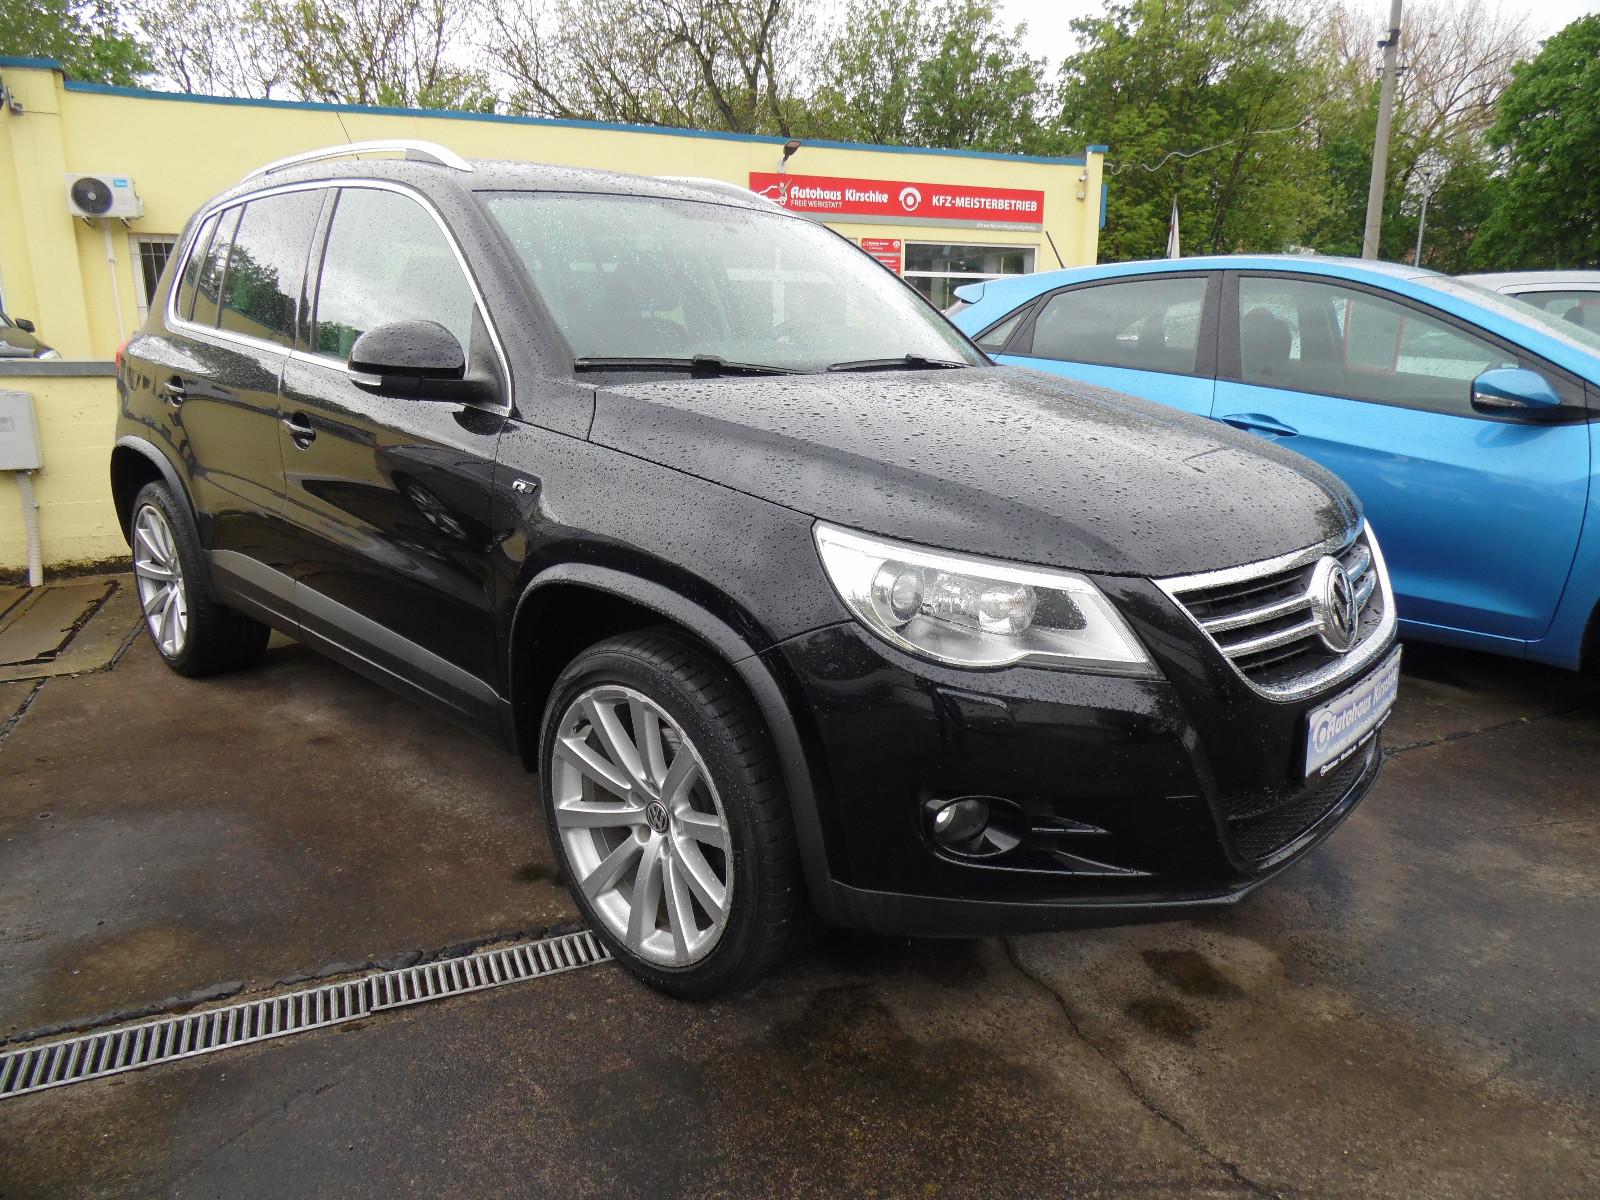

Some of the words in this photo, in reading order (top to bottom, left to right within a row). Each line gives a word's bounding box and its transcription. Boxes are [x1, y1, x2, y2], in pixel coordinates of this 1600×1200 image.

[790, 186, 842, 201] Autohaus
[845, 188, 888, 203] Kirschke
[790, 200, 807, 208] FREIE
[807, 200, 842, 209] WERKSTATT
[932, 195, 1038, 212] KFZ-MEISTERBETRIEB
[1327, 695, 1371, 736] Autohaus
